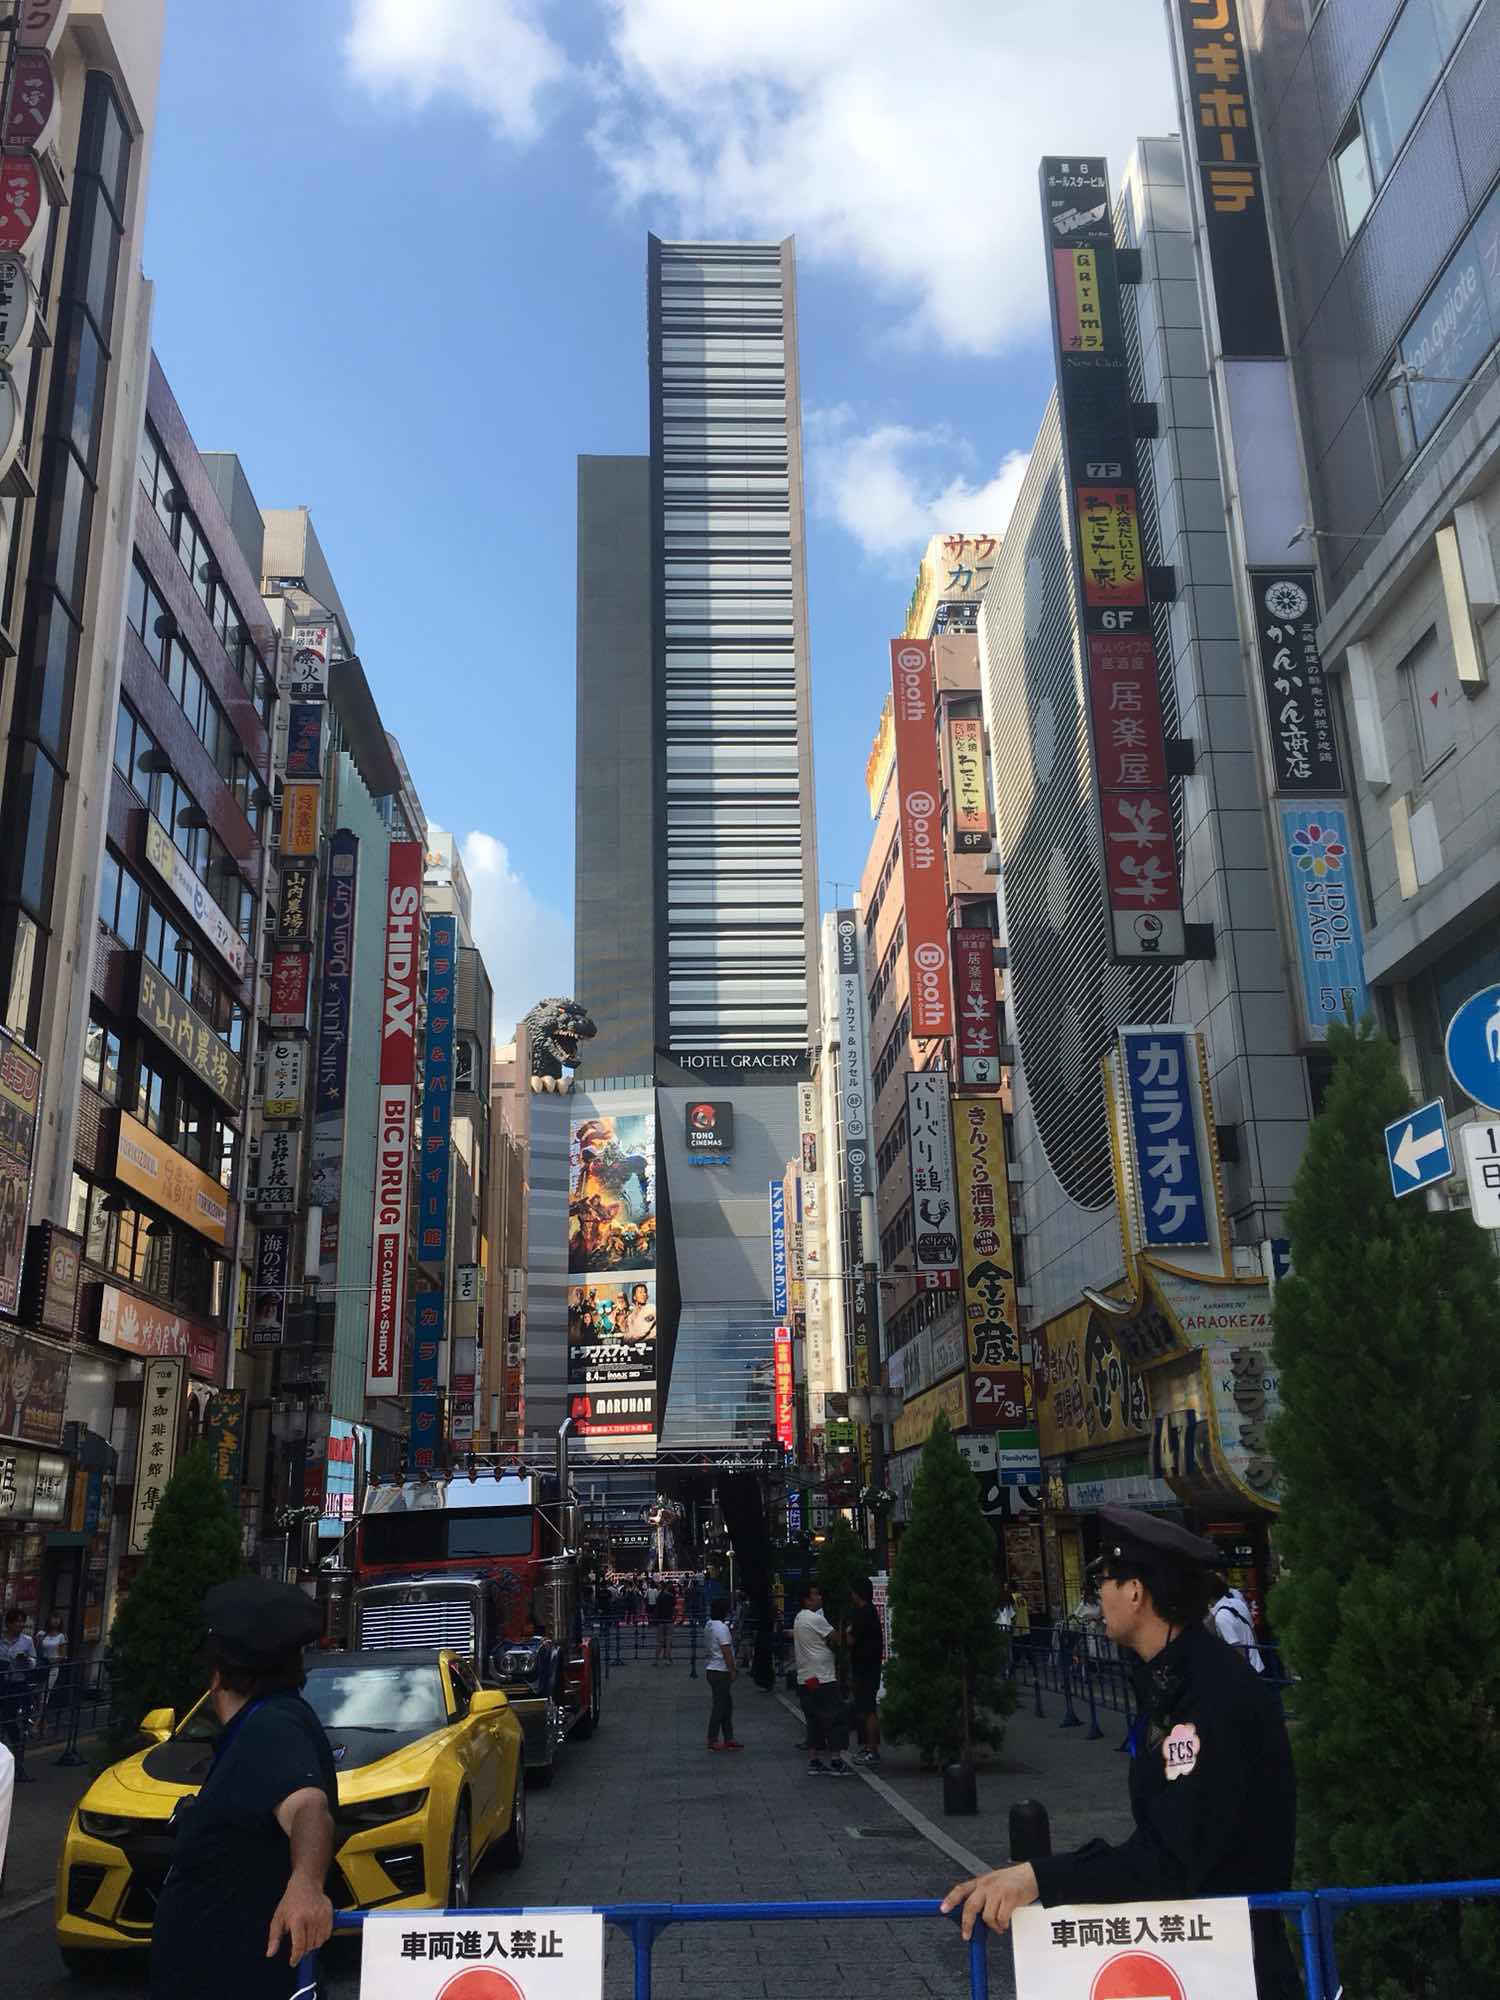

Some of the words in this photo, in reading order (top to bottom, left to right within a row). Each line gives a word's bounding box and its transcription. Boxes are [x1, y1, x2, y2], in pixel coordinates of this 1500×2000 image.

[13, 79, 45, 125] つぼ八
[1090, 464, 1118, 477] 7F
[1102, 611, 1134, 629] 6F
[897, 647, 927, 722] Booth
[1110, 682, 1152, 784] 居楽屋
[906, 791, 936, 870] Booth
[964, 834, 983, 845] 6F
[282, 872, 306, 928] 山内農場
[1304, 881, 1333, 962] STAGE
[1325, 882, 1352, 953] IDOL
[384, 886, 418, 1039] SHIDAX
[838, 920, 856, 965] Booth
[914, 942, 945, 1026] Booth
[156, 989, 229, 1097] 山内農場
[680, 1055, 727, 1069] HOTEL
[731, 1054, 799, 1068] GRACERY
[273, 1102, 292, 1113] 3F
[384, 1100, 405, 1143] BIC
[691, 1132, 714, 1140] TOHO
[691, 1139, 722, 1147] CINEMAS
[1137, 1042, 1197, 1235] カラオケ
[379, 1151, 405, 1225] DRUG
[968, 1106, 996, 1228] きんくら酒場
[262, 1234, 283, 1286] 海の家
[382, 1239, 392, 1258] BIC
[976, 1245, 999, 1254] KURA
[378, 1258, 392, 1312] CAMERA
[925, 1271, 951, 1288] B1
[967, 1260, 1019, 1365] 金の蔵
[377, 1319, 391, 1373] SHIDAX
[570, 1342, 653, 1360] トランスフォーマー
[585, 1371, 599, 1382] 8.4
[974, 1376, 1006, 1404] 2F
[596, 1397, 652, 1415] MARUHAN
[1002, 1453, 1038, 1462] FamilyMart
[1168, 1740, 1195, 1762] FCS
[401, 1930, 563, 1960] 車両進入禁止
[1051, 1914, 1213, 1948] 車両進入禁止
